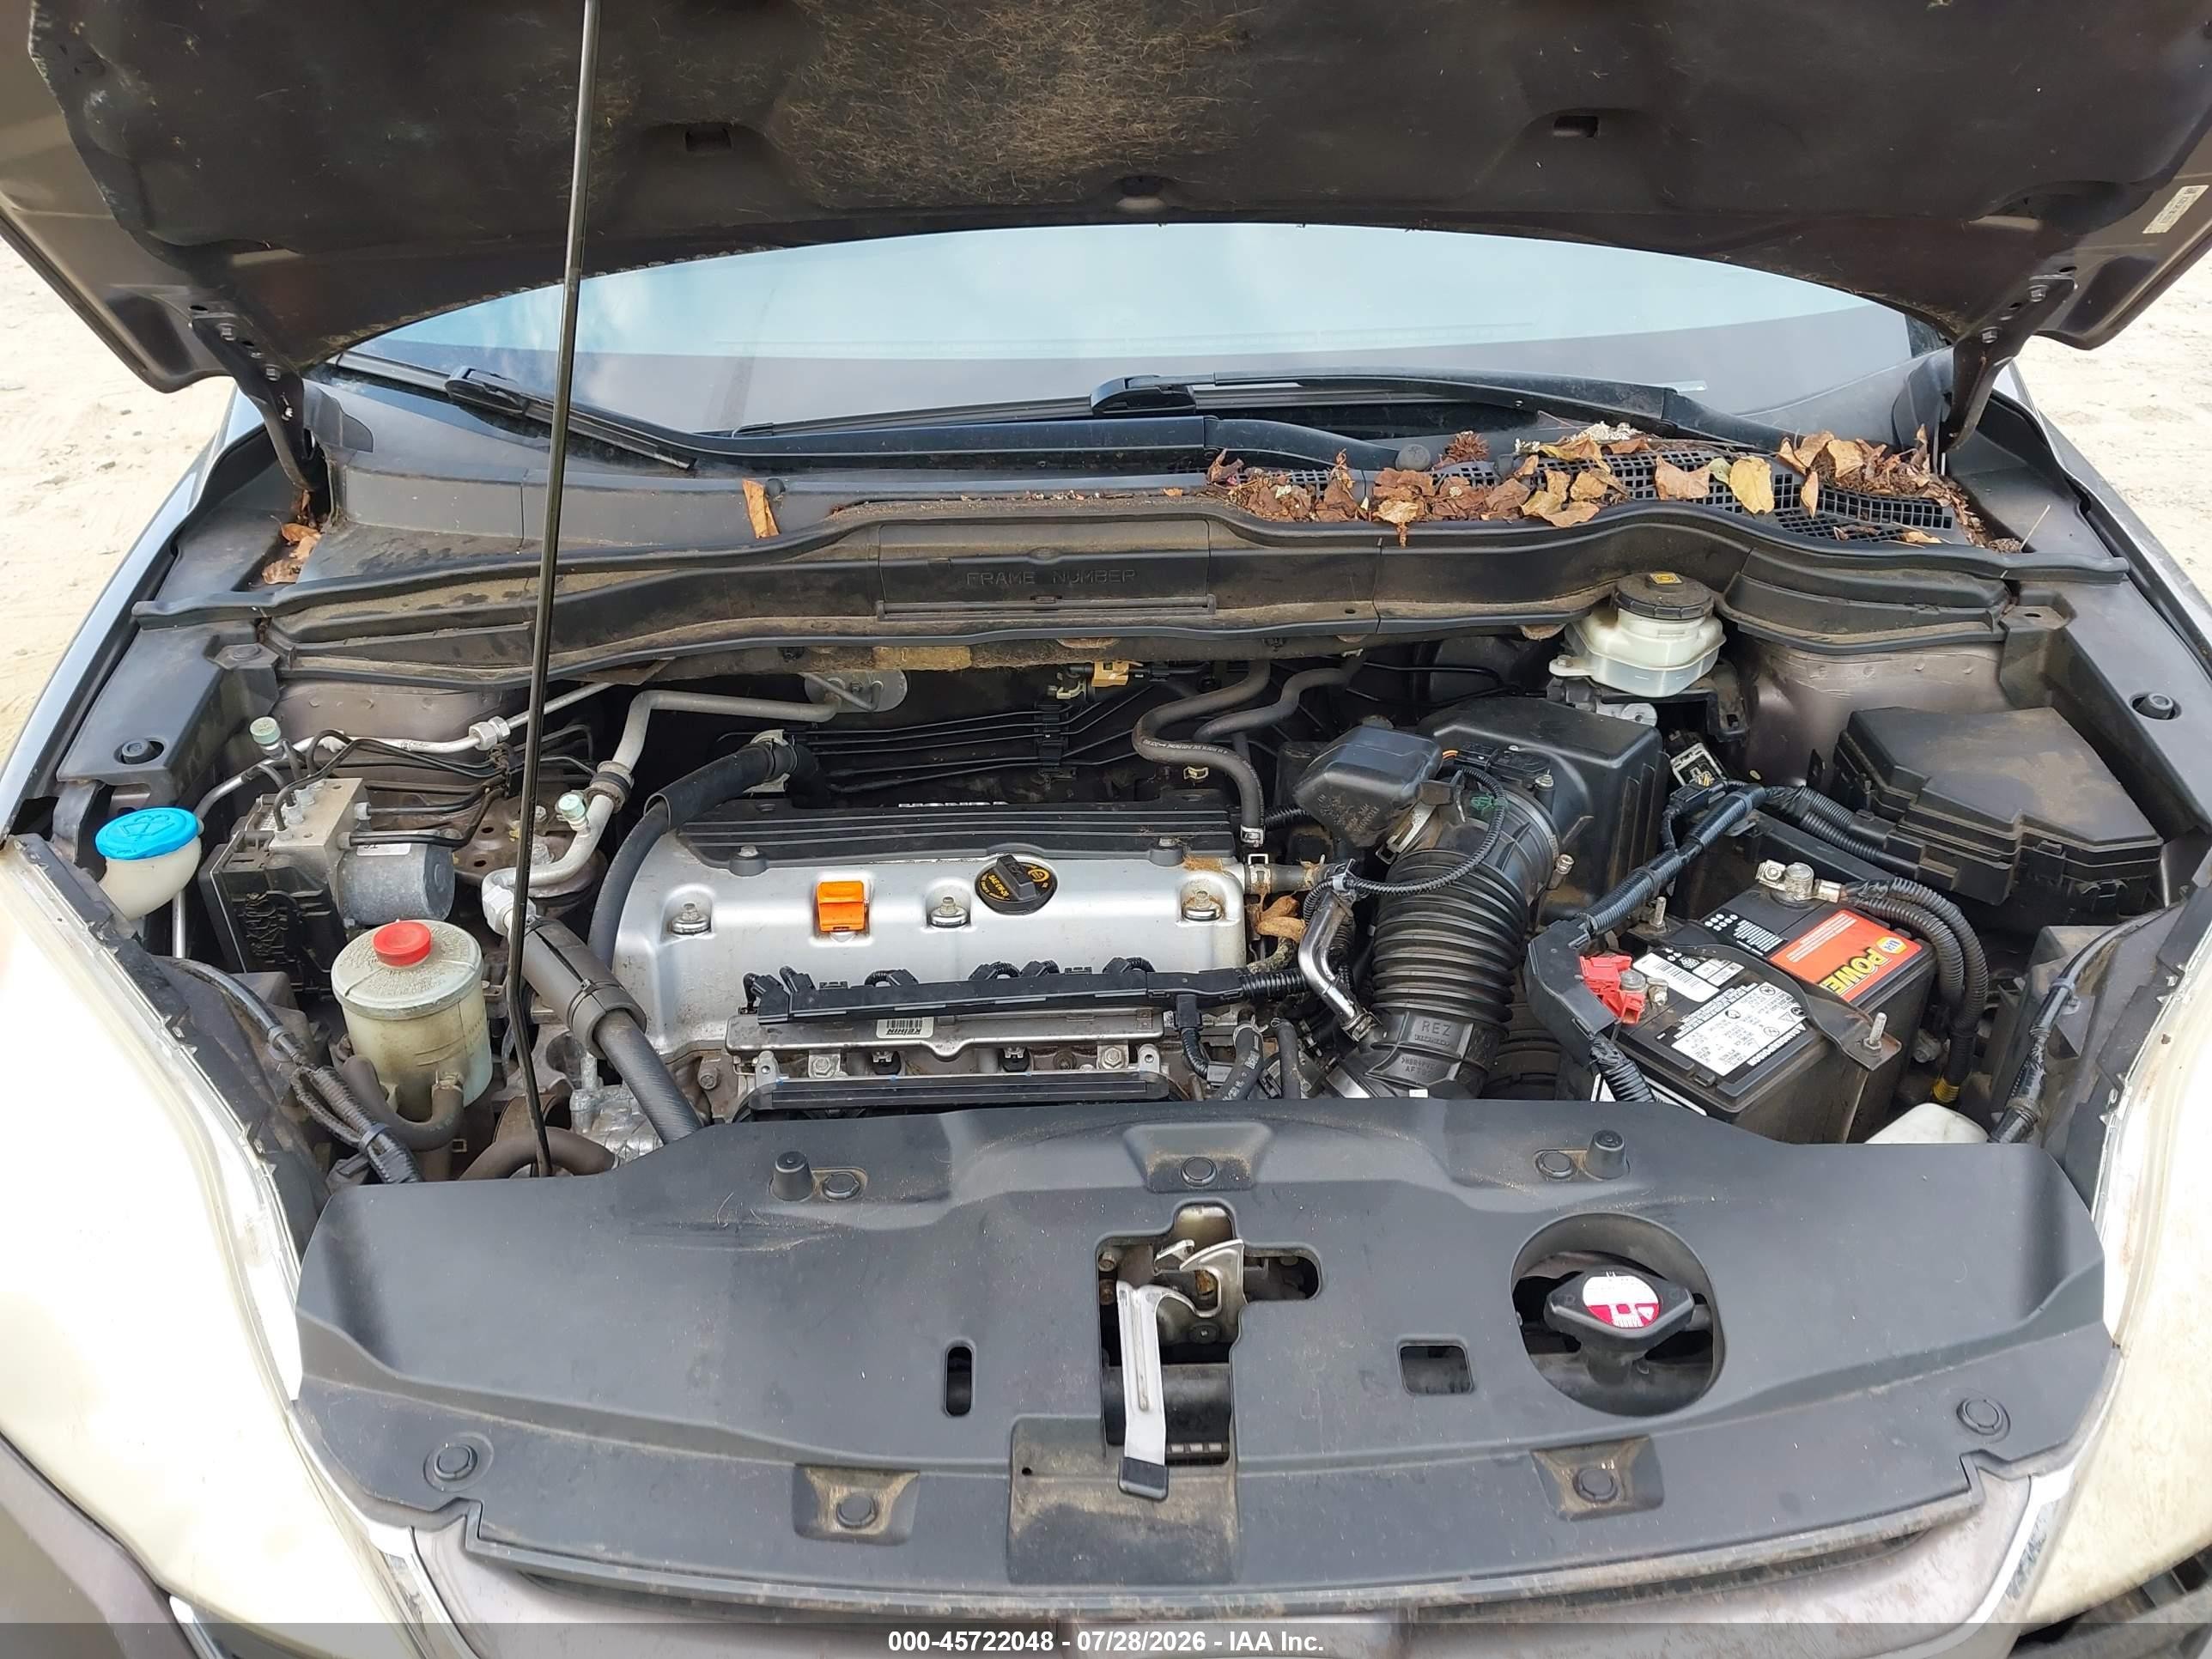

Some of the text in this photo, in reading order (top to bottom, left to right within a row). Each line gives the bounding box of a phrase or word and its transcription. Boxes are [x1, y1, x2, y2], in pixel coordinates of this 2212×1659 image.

[967, 569, 1137, 586] FRAME NUMBER
[1819, 947, 1891, 996] POWE
[1422, 1020, 1451, 1036] REZ
